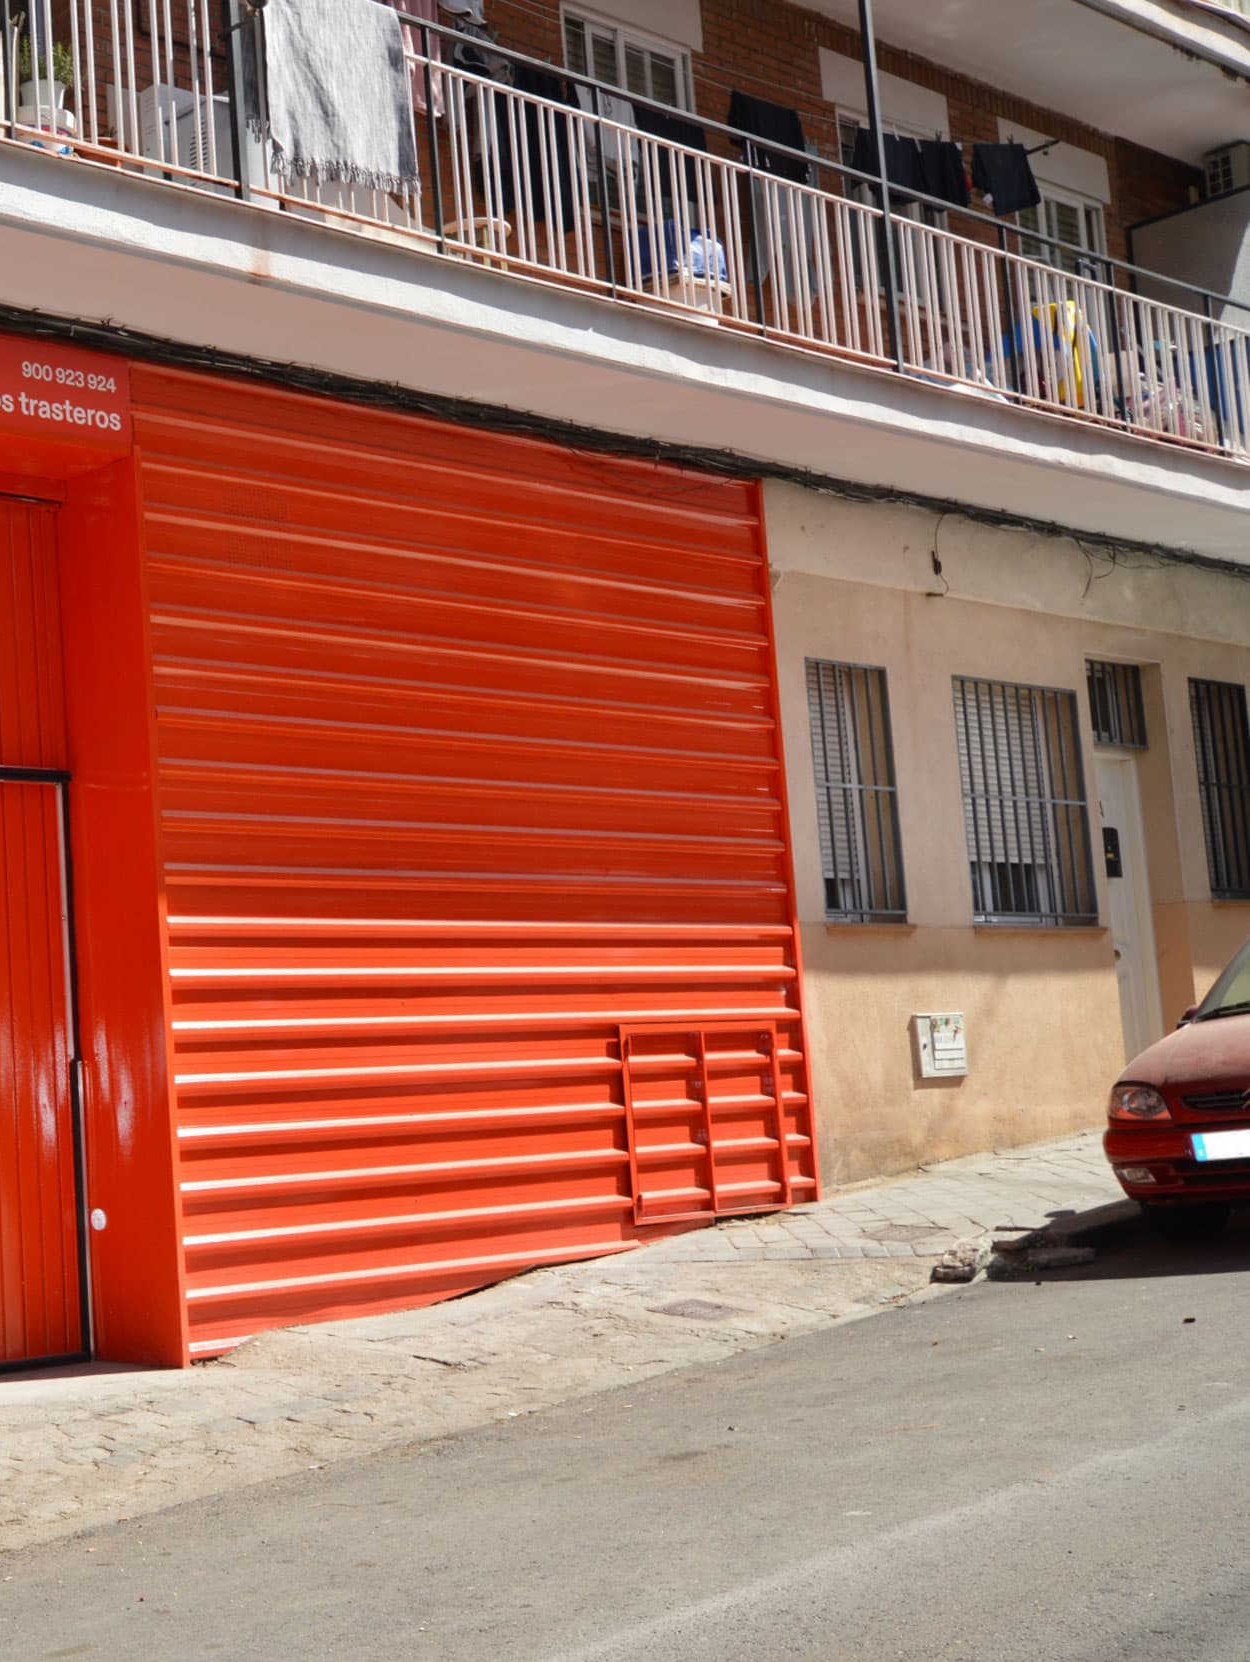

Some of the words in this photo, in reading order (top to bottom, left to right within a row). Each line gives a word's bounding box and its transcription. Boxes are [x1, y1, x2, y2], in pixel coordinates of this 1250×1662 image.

[22, 361, 51, 381] 900
[55, 367, 84, 388] 923
[87, 374, 117, 392] 924
[18, 391, 121, 431] trasteros
